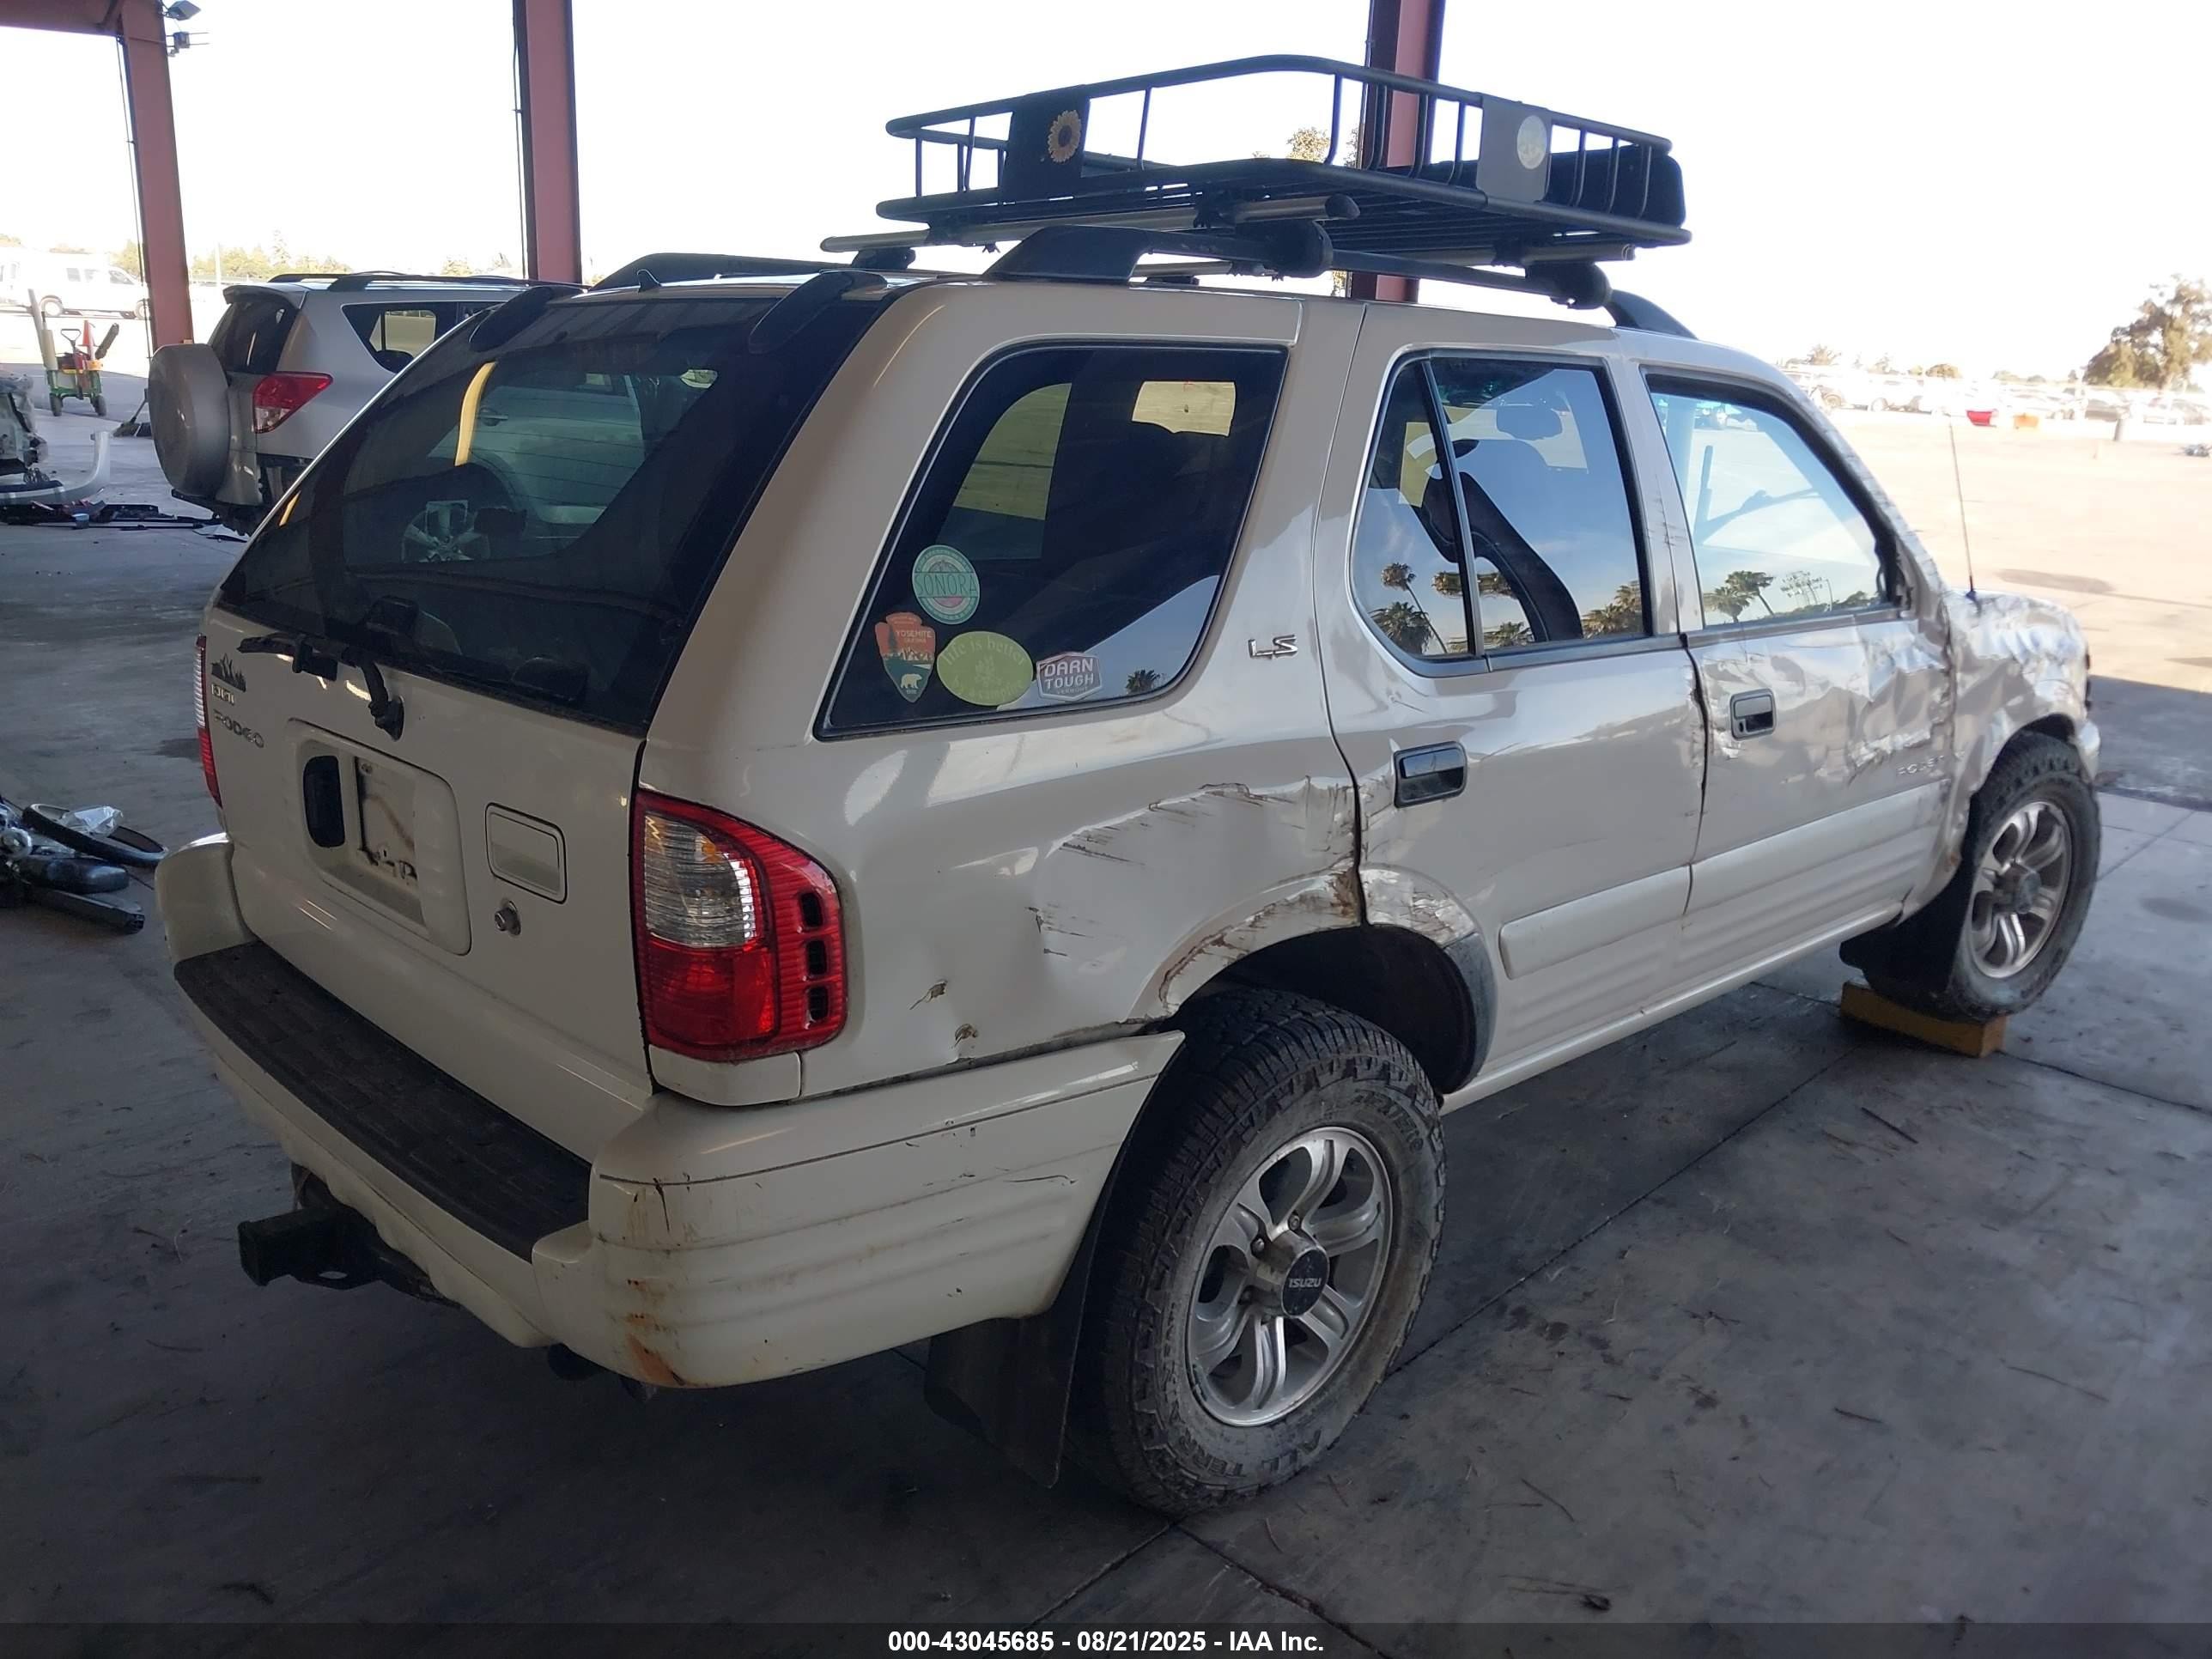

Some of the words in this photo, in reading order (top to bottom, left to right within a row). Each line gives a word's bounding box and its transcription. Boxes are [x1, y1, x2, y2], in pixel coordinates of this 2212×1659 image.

[915, 573, 977, 597] SONORA
[895, 629, 933, 638] YOSEMITE
[940, 641, 967, 665] life
[969, 635, 983, 653] is
[987, 634, 1025, 665] better
[1248, 634, 1298, 659] LS
[1044, 657, 1094, 678] DARN
[1044, 672, 1095, 690] TOUGH
[212, 708, 265, 749] RODEO
[1288, 1277, 1322, 1288] ISUZU
